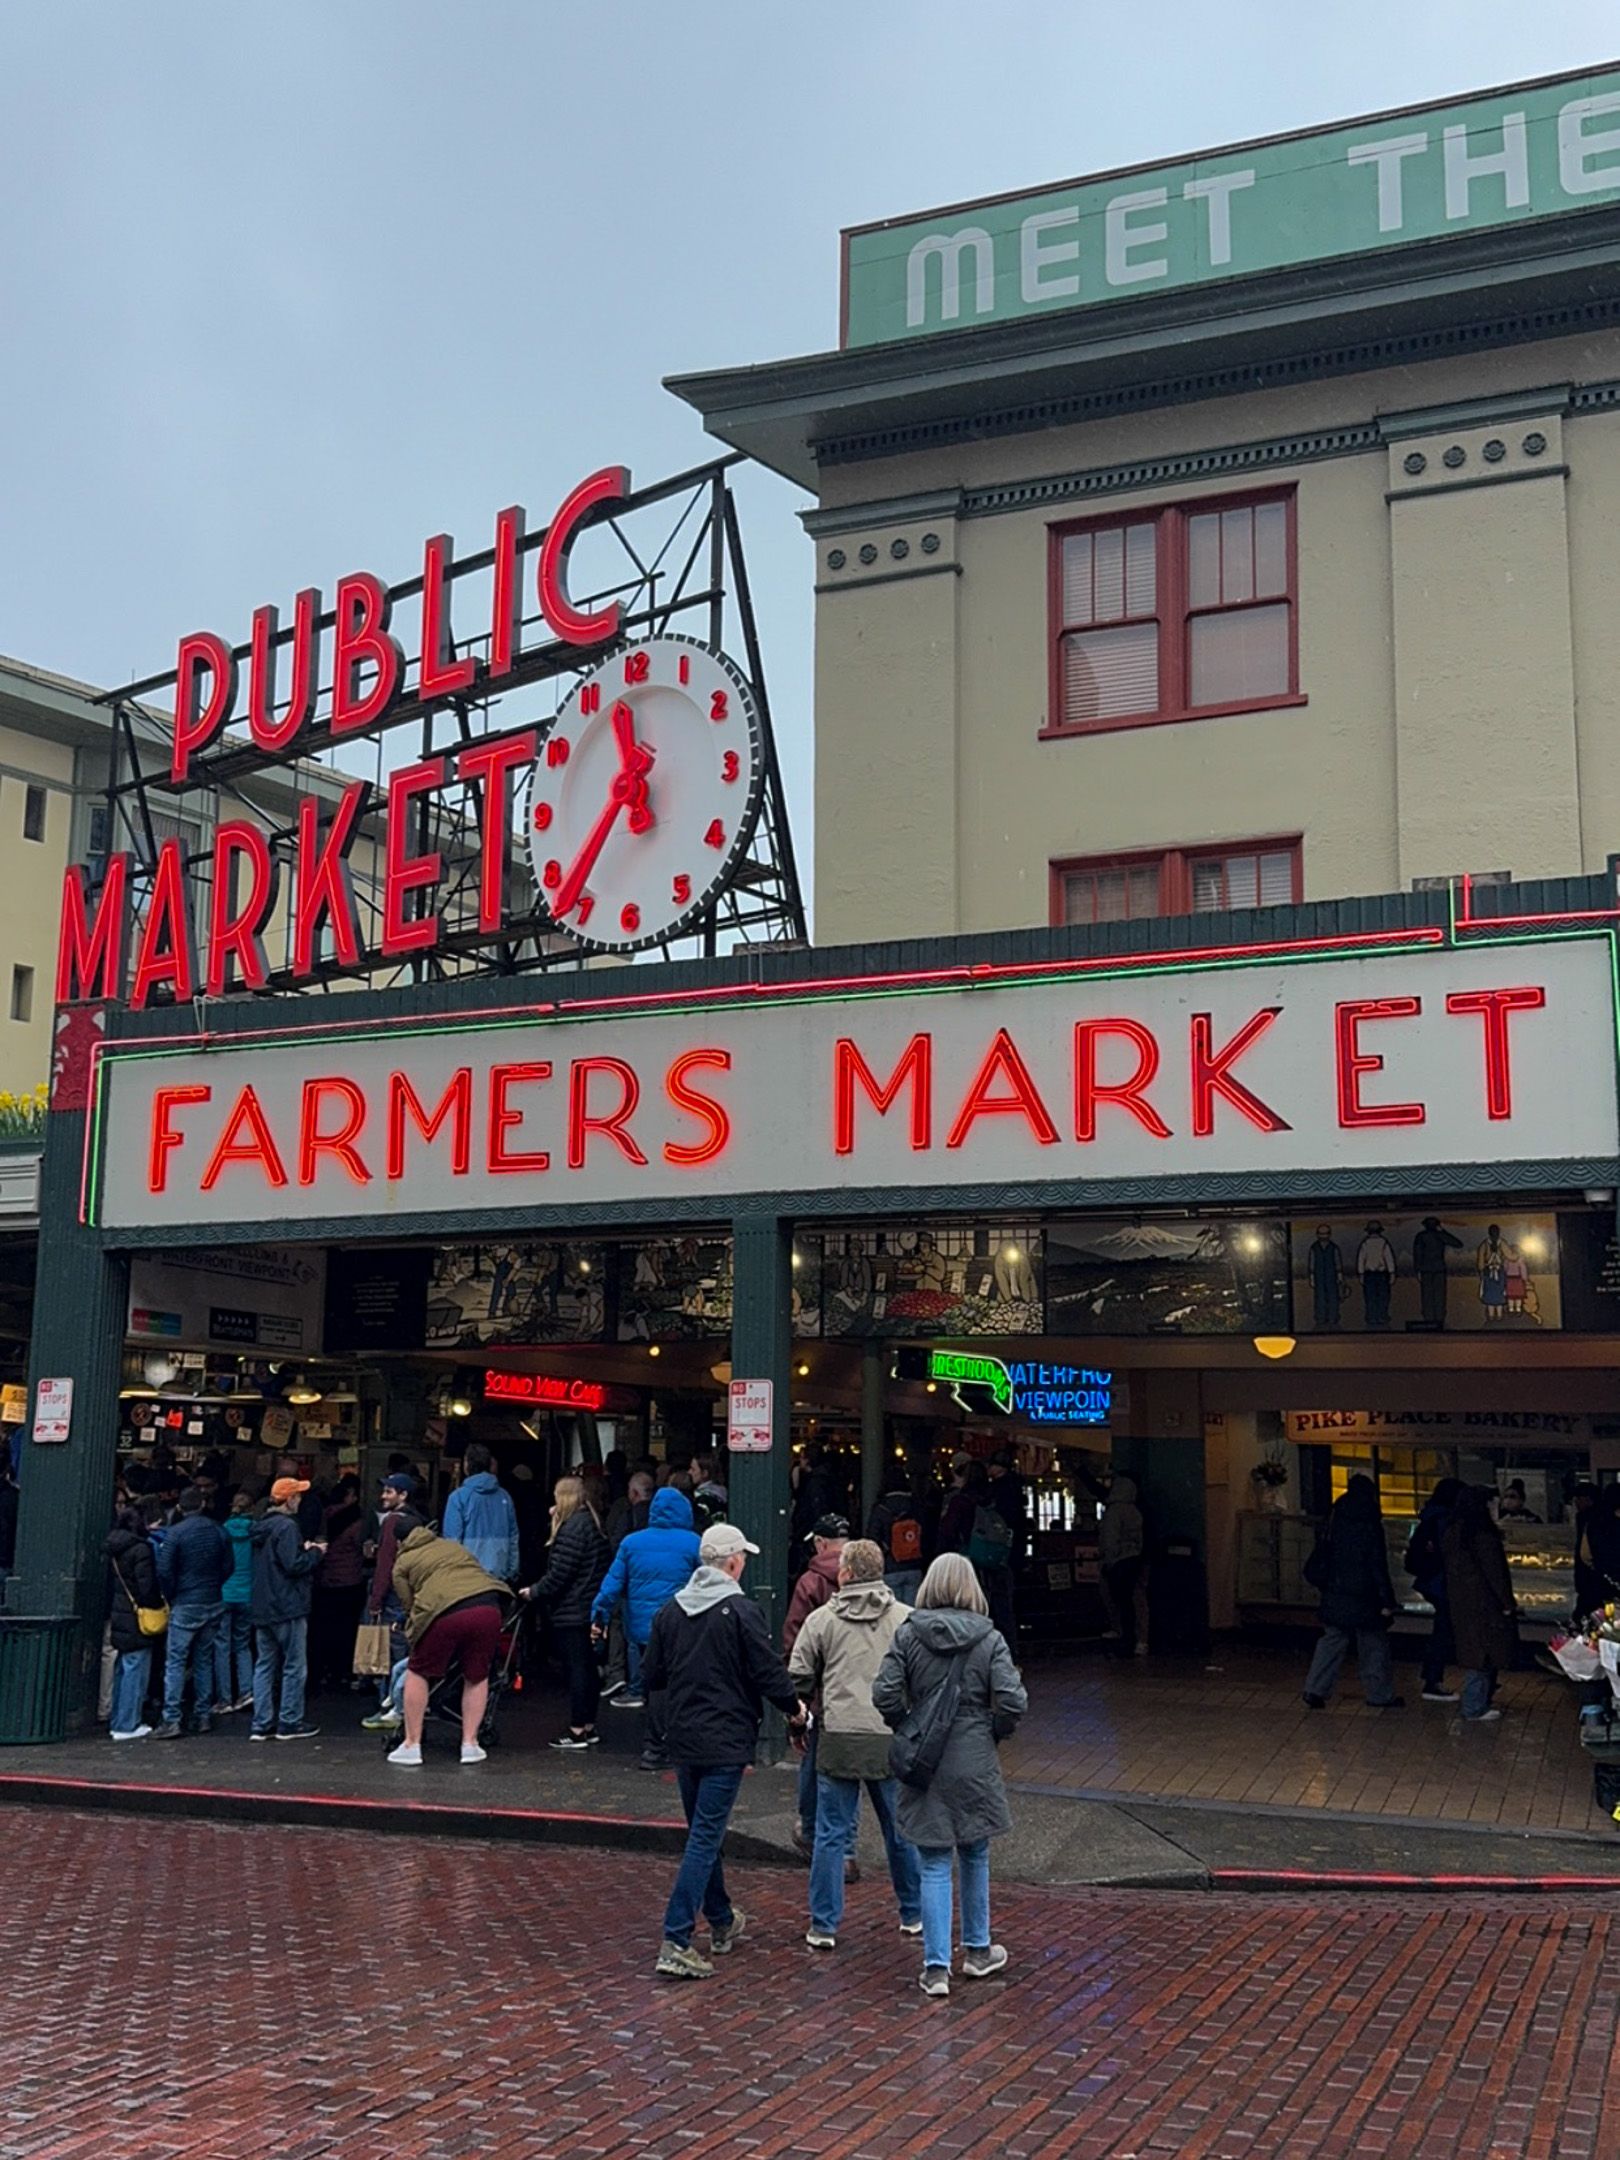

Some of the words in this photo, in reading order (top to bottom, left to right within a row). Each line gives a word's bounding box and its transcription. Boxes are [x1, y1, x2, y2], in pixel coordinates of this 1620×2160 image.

[905, 168, 1256, 328] MEET
[1346, 90, 1620, 233] THE
[171, 464, 631, 784] PUBLIC
[624, 651, 650, 685] 12
[678, 654, 689, 685] 1
[580, 682, 600, 715] 11
[710, 689, 728, 721] 2
[547, 737, 570, 768] 10
[721, 750, 739, 782] 3
[534, 802, 553, 831] 9
[703, 818, 726, 850] 4
[55, 730, 538, 1011] MARKET
[543, 859, 562, 890] 8
[672, 873, 690, 905] 5
[576, 896, 595, 925] 7
[620, 903, 640, 933] 6
[148, 1047, 732, 1193] FARMERS
[834, 986, 1546, 1156] MARKET
[733, 1383, 744, 1393] NO
[936, 1355, 1010, 1400] RESTROOMS
[42, 1394, 67, 1405] STOPS
[735, 1397, 766, 1408] STOPS
[1068, 1410, 1105, 1420] SEATING
[1295, 1411, 1357, 1431] PIKE
[1368, 1412, 1451, 1424] PLACE
[1464, 1412, 1581, 1434] BAKERY
